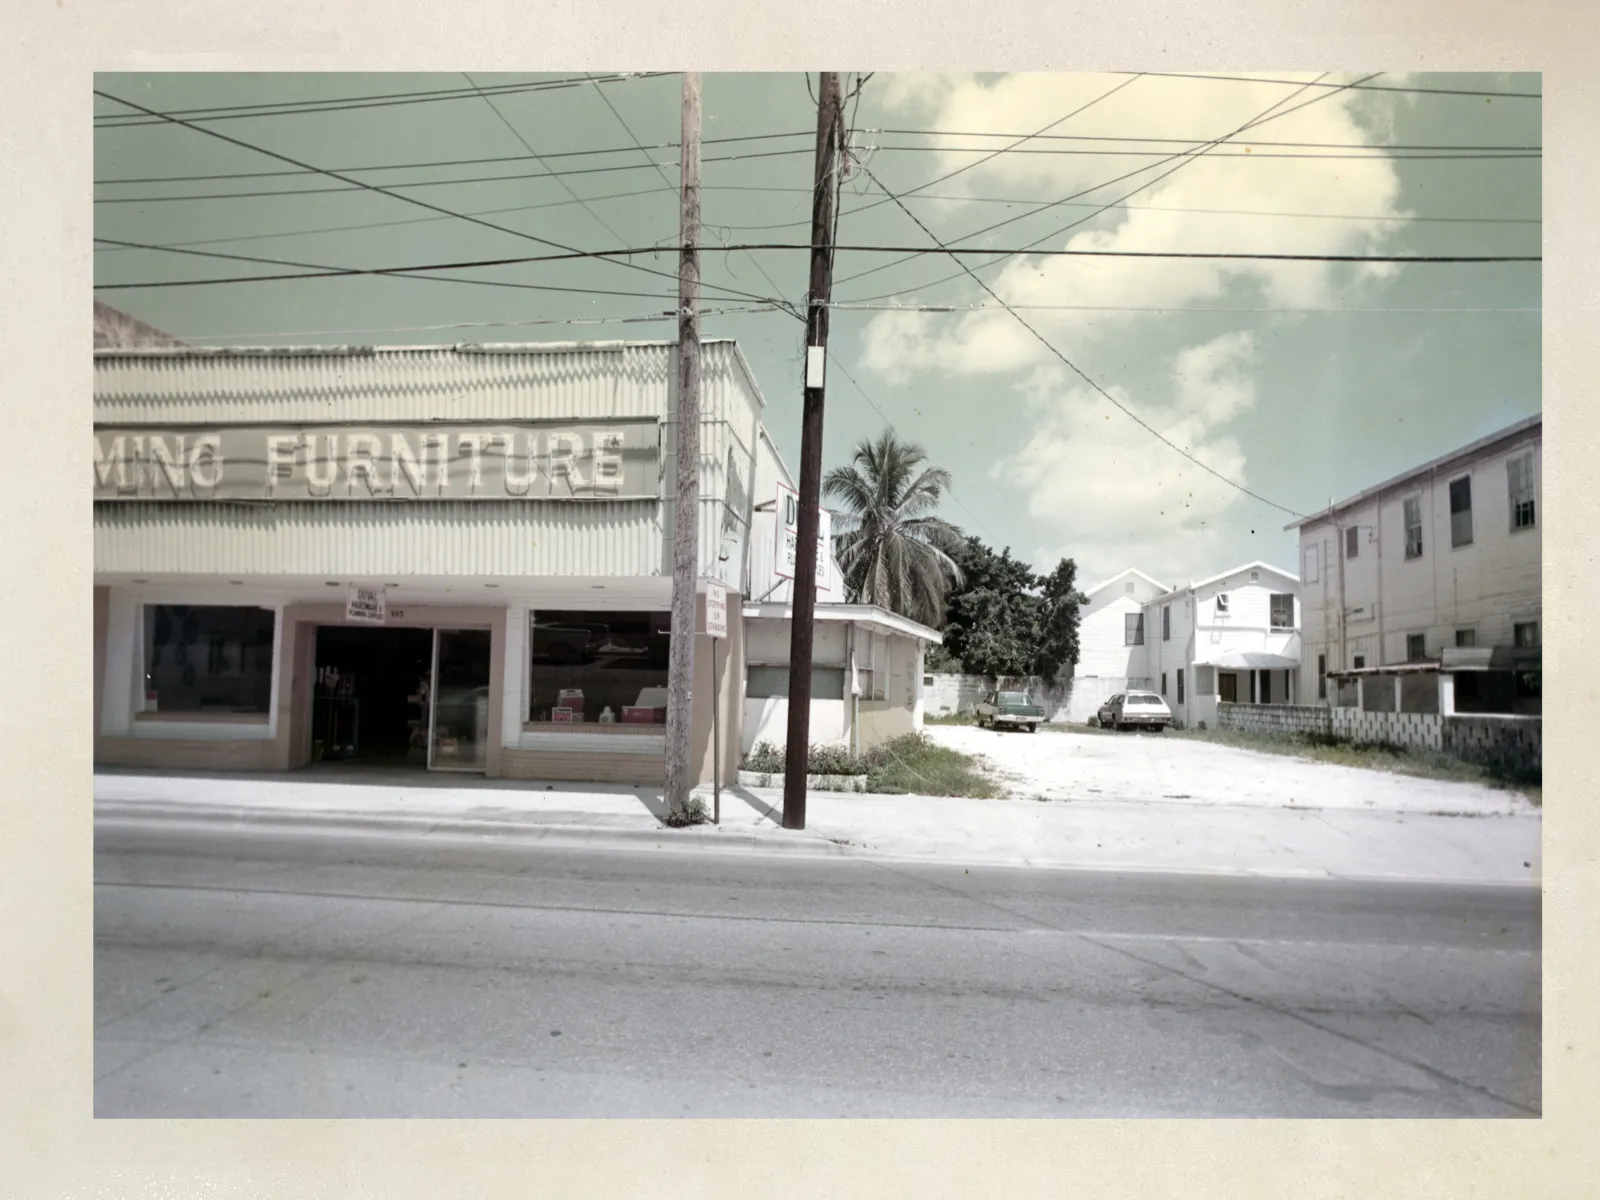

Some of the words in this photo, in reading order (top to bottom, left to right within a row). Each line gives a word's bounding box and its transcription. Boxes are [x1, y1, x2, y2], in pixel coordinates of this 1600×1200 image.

[265, 432, 625, 487] FURNITURE
[358, 589, 377, 601] DUVAL
[713, 589, 720, 598] NO
[708, 621, 726, 633] STANDING
